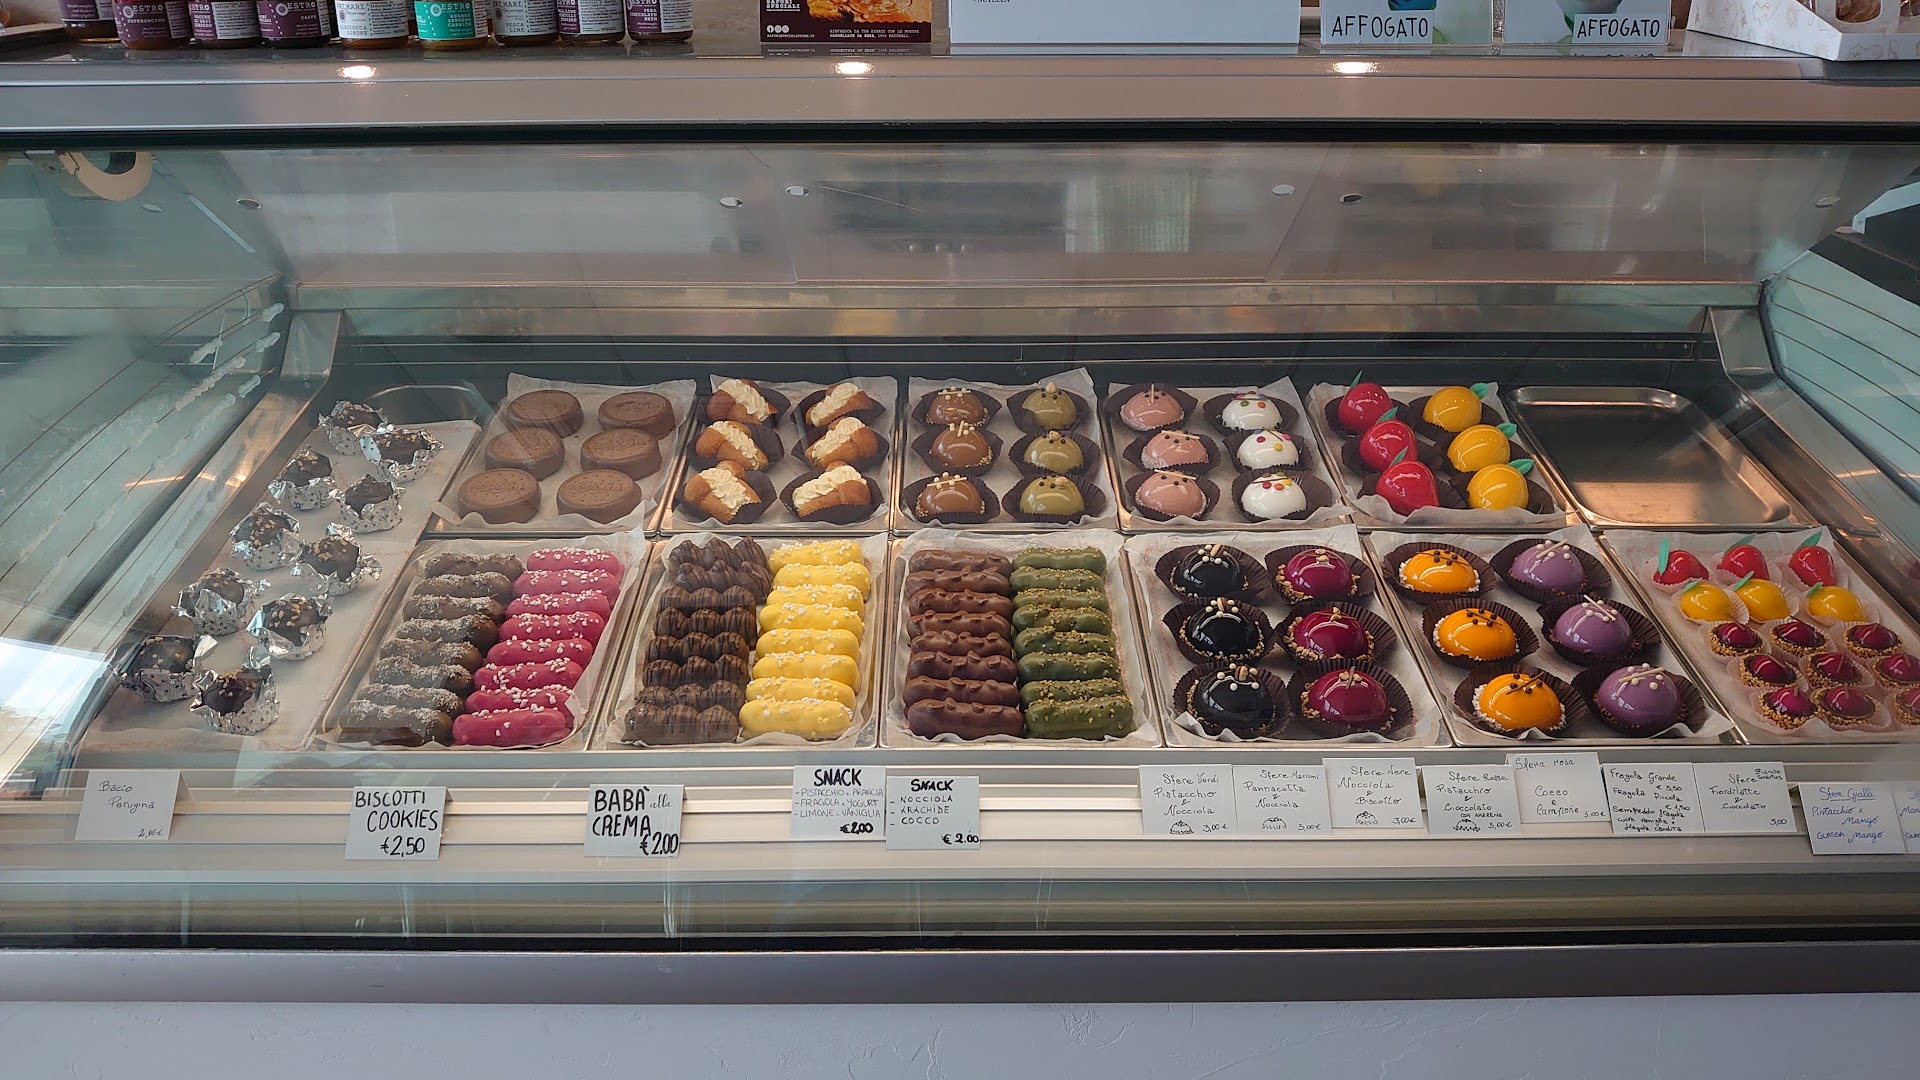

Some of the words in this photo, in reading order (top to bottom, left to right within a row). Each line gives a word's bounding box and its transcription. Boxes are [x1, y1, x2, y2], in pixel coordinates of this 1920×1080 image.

[1331, 15, 1428, 38] AFFOGATO
[1577, 18, 1660, 38] AFFOGATO
[1260, 769, 1289, 780] Sfere
[1350, 765, 1385, 776] Sfere
[1387, 764, 1412, 776] Nere
[1609, 767, 1644, 782] Fragola
[1648, 772, 1678, 784] Grande
[813, 768, 862, 786] SNACK
[1162, 773, 1194, 785] Sfere
[1337, 776, 1394, 789] Nocciola
[1448, 770, 1480, 783] Sfere
[1728, 773, 1758, 785] Sfere
[98, 781, 133, 793] Bacio
[911, 778, 954, 792] SNACK
[1243, 780, 1307, 793] Pannacotta
[1435, 783, 1492, 794] Pistacchio
[1709, 785, 1761, 796] Fiordilatte
[801, 788, 845, 797] PISTACCHIO
[900, 794, 953, 803] NOCCIOLA
[1153, 787, 1217, 799] Pistacchio
[1819, 786, 1844, 800] Sfere
[355, 790, 426, 808] BISCOTTI
[649, 793, 671, 809] alla
[800, 798, 839, 807] FRAGOLA
[847, 799, 878, 809] YOGURT
[1255, 797, 1300, 808] Nocciola
[1355, 796, 1402, 805] Biscotto
[900, 805, 950, 814] ARACHIDE
[1164, 804, 1215, 817] Nocciola
[1443, 802, 1492, 811] Cioccolato
[800, 809, 834, 818] LIMONE
[842, 808, 880, 818] VANIGLIA
[367, 809, 439, 832] COOKIES
[592, 814, 651, 837] CREMA
[901, 817, 940, 825] COCCO
[1841, 815, 1879, 828] Mango
[1848, 830, 1885, 844] Mango
[380, 835, 425, 857] €2,50
